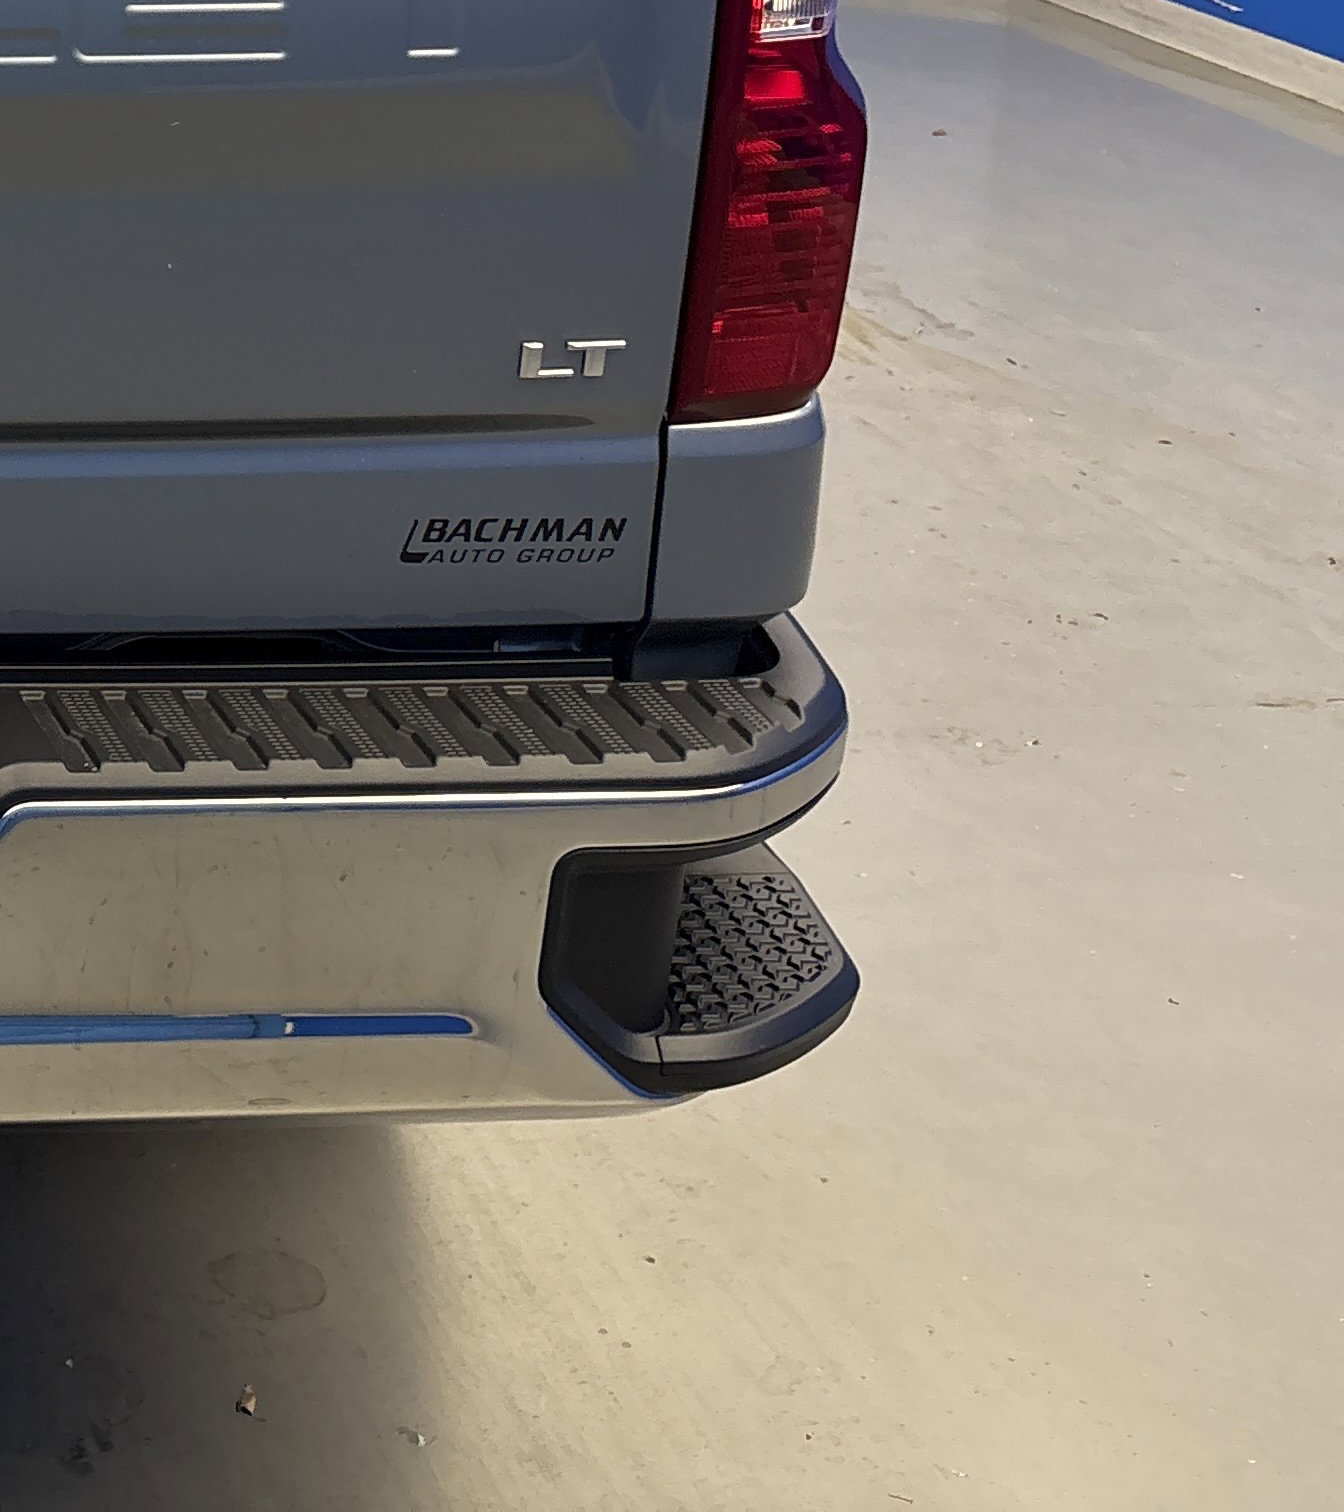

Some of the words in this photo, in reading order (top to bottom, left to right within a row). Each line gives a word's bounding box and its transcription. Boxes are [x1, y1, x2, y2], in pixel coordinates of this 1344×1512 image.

[519, 340, 627, 378] LT
[422, 517, 628, 543] BACHMAN
[427, 548, 505, 564] AUTO
[516, 548, 615, 563] GROUP
